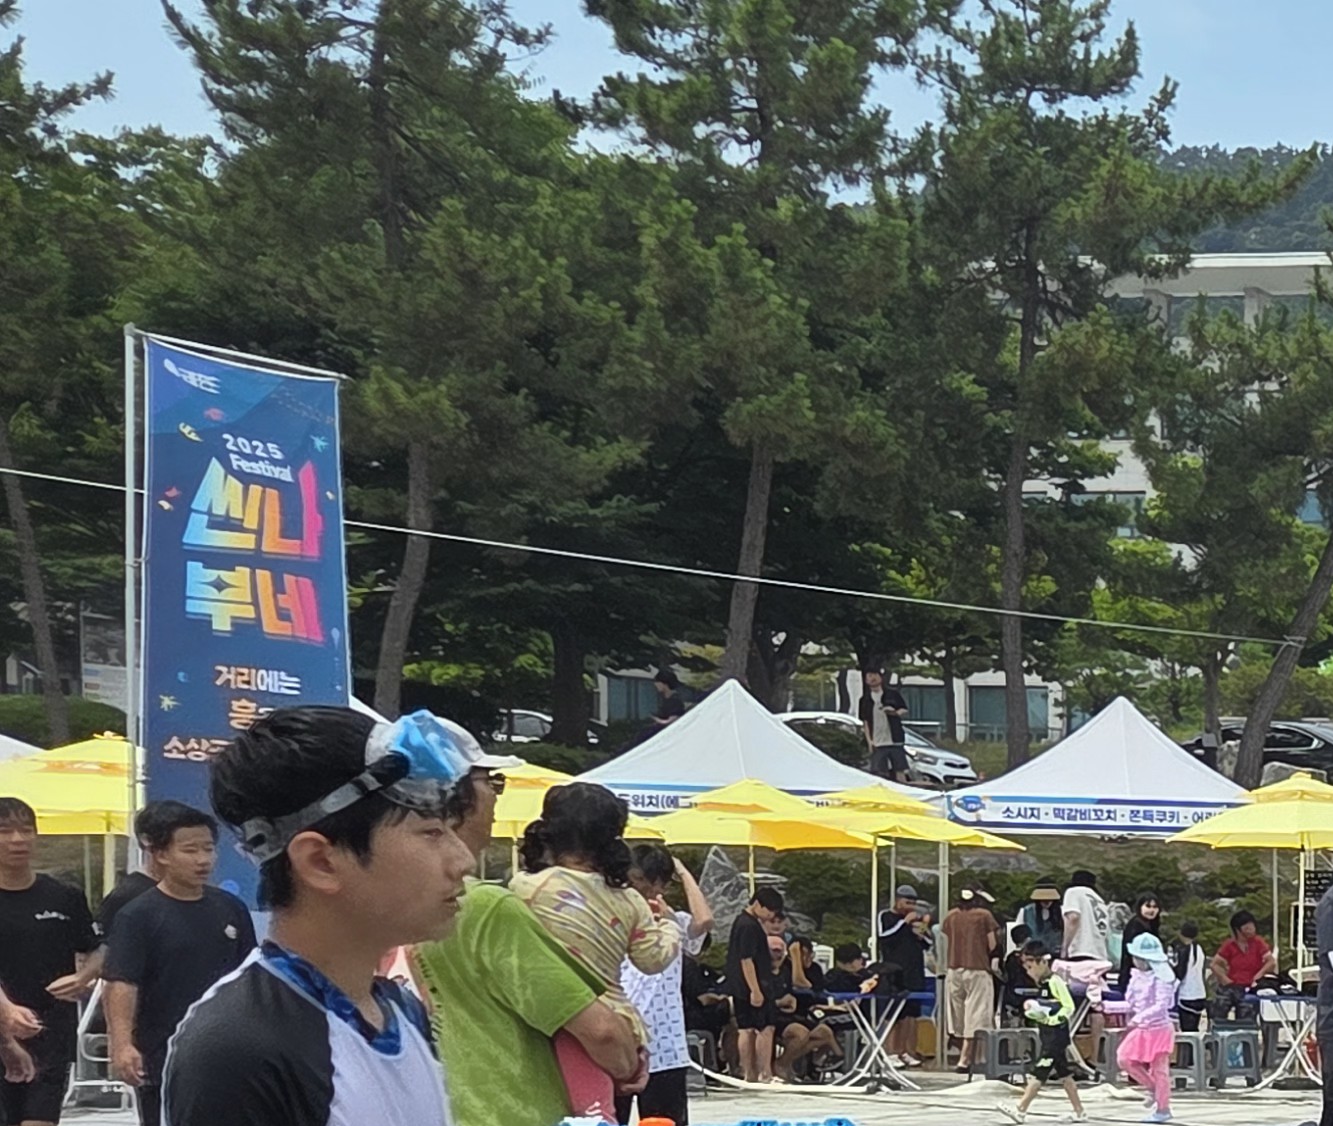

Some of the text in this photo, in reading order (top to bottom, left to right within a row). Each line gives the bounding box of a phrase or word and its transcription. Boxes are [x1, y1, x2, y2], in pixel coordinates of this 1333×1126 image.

[222, 433, 285, 460] 2025
[229, 453, 295, 483] Festival
[214, 664, 302, 695] 거리에는
[1001, 806, 1041, 821] 소시지
[1053, 807, 1117, 822] 떡갈비꼬치
[1119, 809, 1180, 824] 쫀득쿠키
